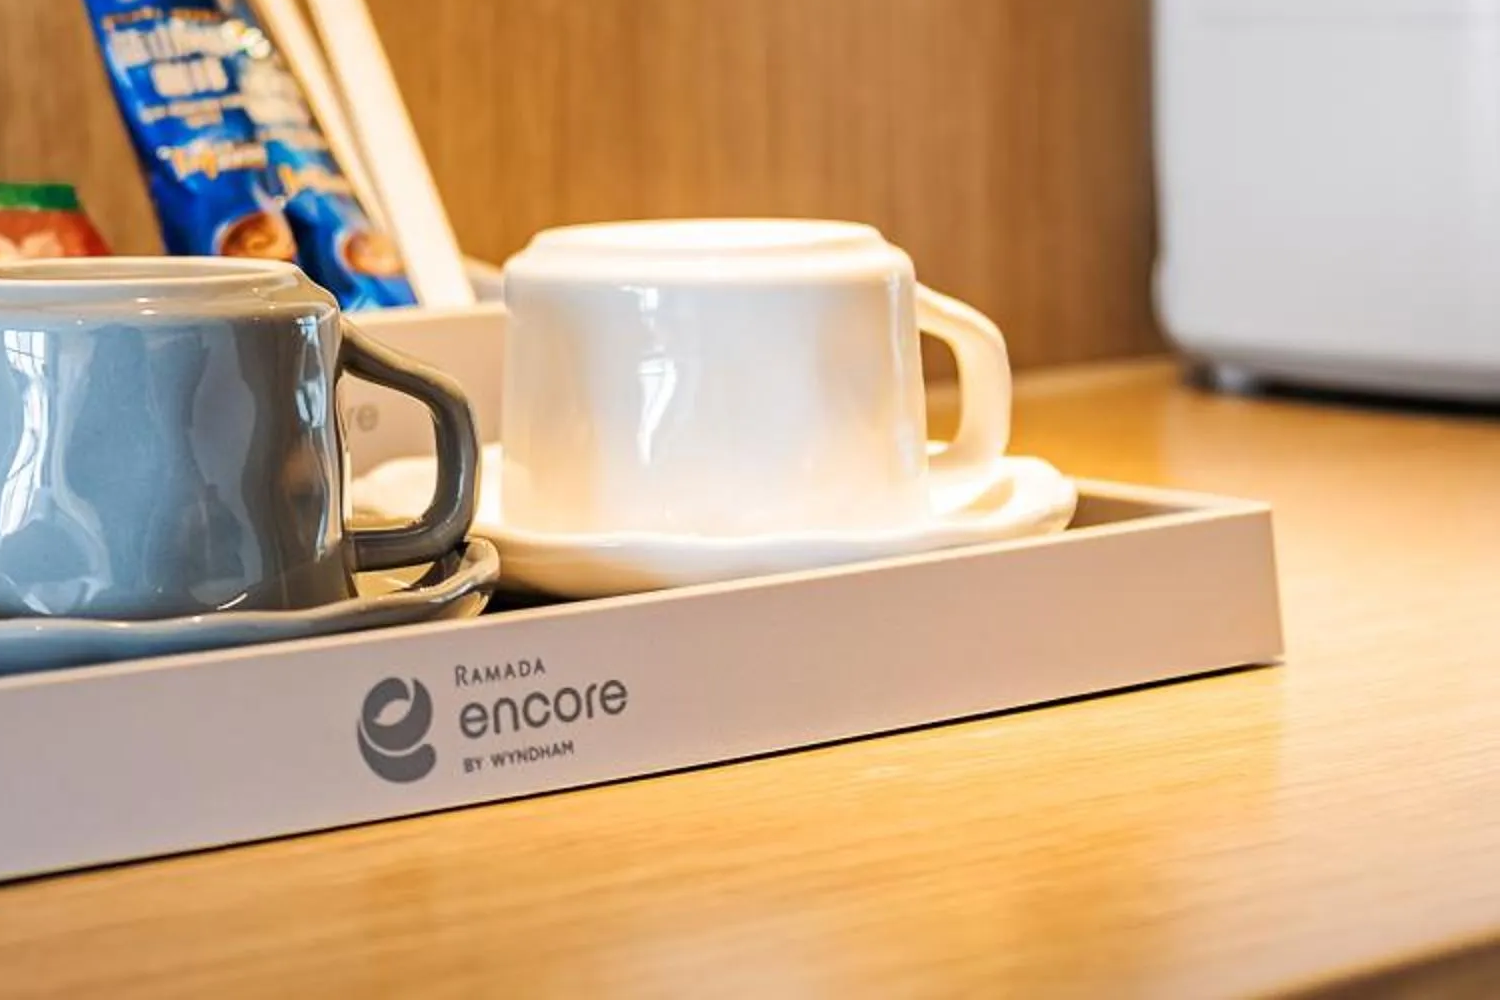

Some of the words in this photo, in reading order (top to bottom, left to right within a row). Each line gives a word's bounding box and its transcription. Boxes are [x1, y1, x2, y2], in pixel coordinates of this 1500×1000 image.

[453, 657, 546, 687] RAMADA
[459, 679, 628, 739] encore
[463, 757, 483, 773] BY
[490, 740, 575, 768] WYNDHAM
